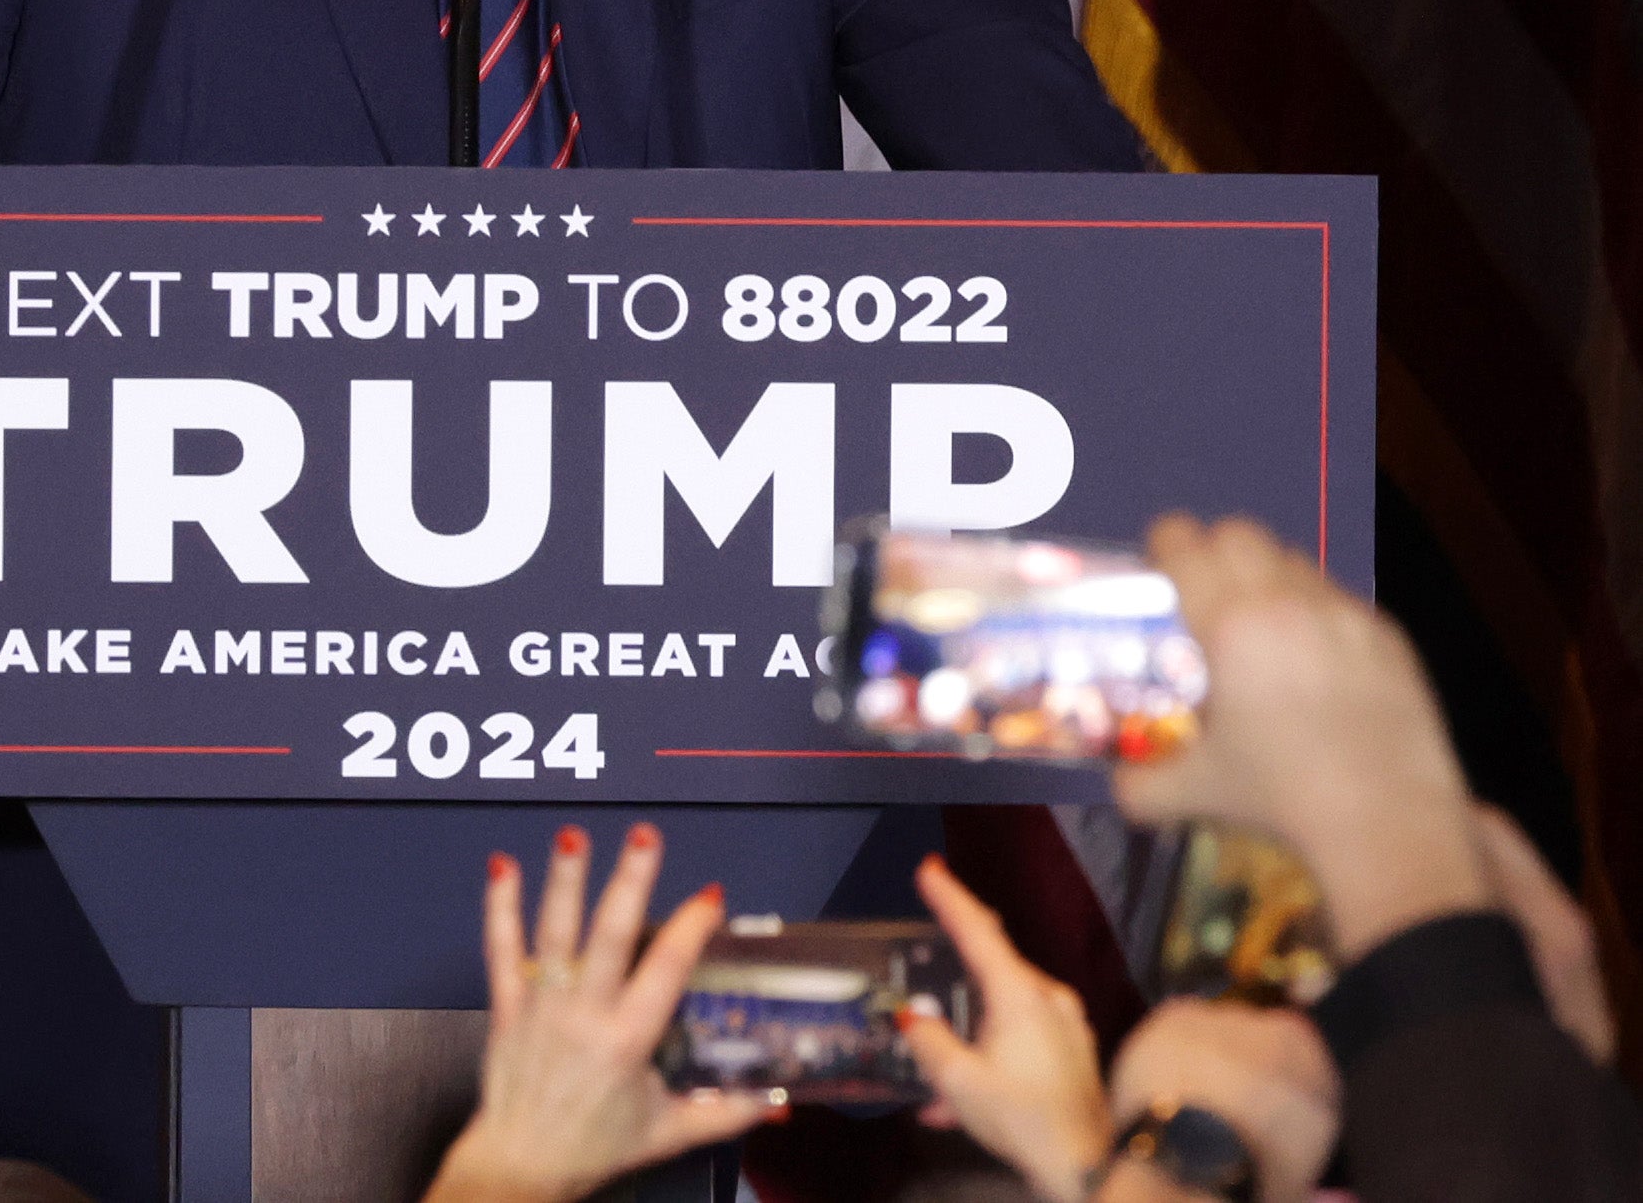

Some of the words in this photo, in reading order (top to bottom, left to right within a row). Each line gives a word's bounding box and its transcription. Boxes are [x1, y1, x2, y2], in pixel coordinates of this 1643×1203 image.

[211, 271, 540, 340] TRUMP
[567, 273, 690, 341] TO
[721, 274, 1009, 343] 88022
[160, 629, 481, 676] AMERICA
[508, 631, 737, 678] GREAT
[341, 711, 605, 780] 2024
